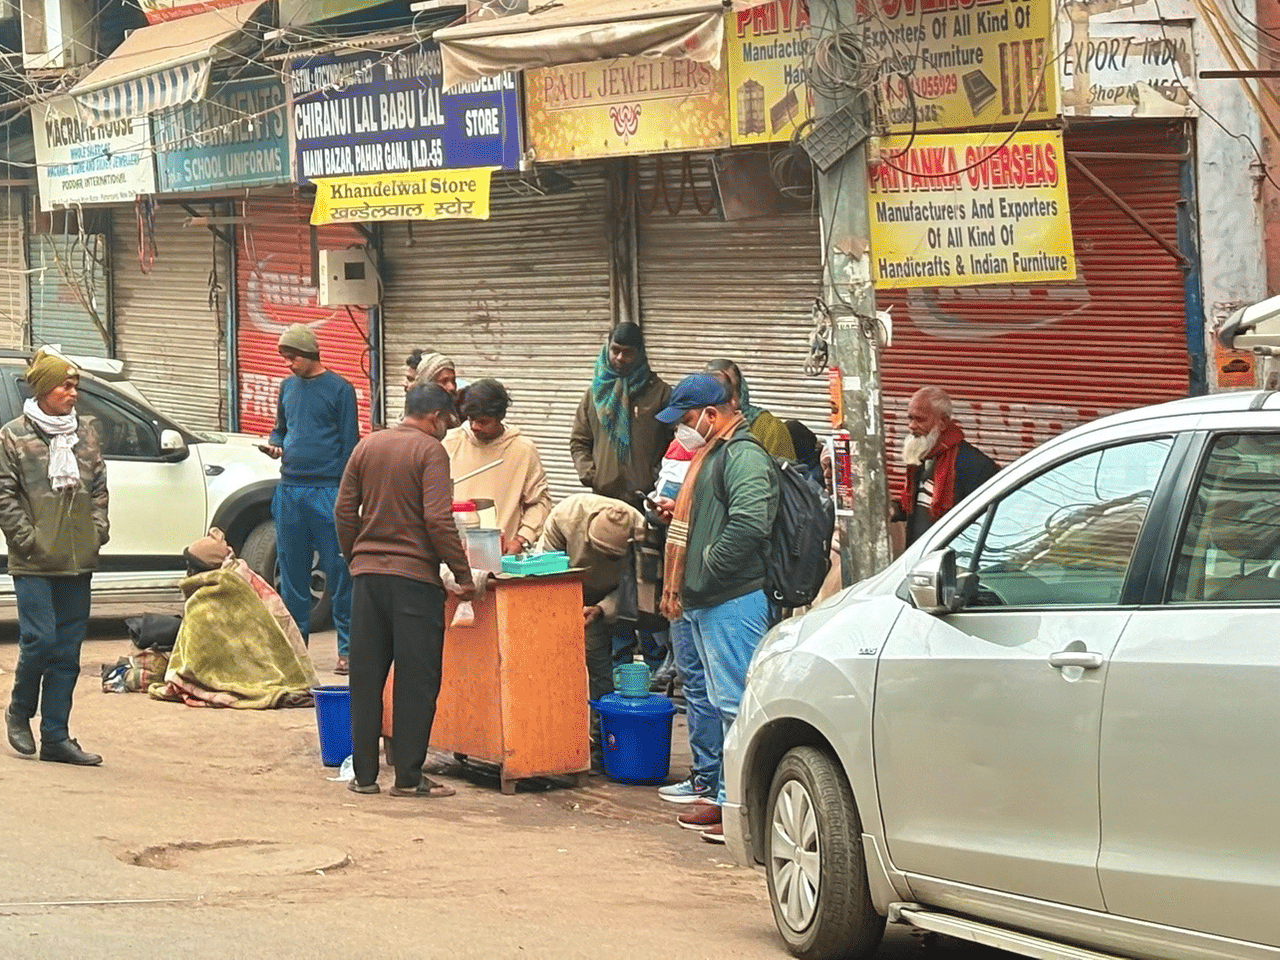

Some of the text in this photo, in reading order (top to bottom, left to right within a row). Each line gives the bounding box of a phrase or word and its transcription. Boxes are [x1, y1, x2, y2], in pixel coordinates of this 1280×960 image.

[931, 16, 947, 40] Of
[953, 13, 971, 37] All
[976, 10, 1008, 35] Kind
[1015, 6, 1031, 29] Of
[921, 44, 984, 69] Furniture
[1063, 36, 1136, 77] EXPORT
[543, 57, 713, 103] PAUL JEWELLERS
[294, 87, 445, 140] CHIRANJI LAL BABU LAL
[465, 107, 500, 137] STORE
[183, 147, 282, 182] SCHOOL UNIFORMS
[302, 147, 324, 177] MAIN
[324, 145, 354, 175] BAZAR,
[355, 142, 383, 172] PAHAR
[870, 141, 1060, 194] PRIYANKA OVERSEAS
[330, 176, 477, 200] Khandelwal Store
[875, 197, 1059, 223] Manufacturers And Exporters
[927, 224, 1015, 249] Of All Kind Of
[878, 251, 1069, 279] Handicrafts & Indian Furniture
